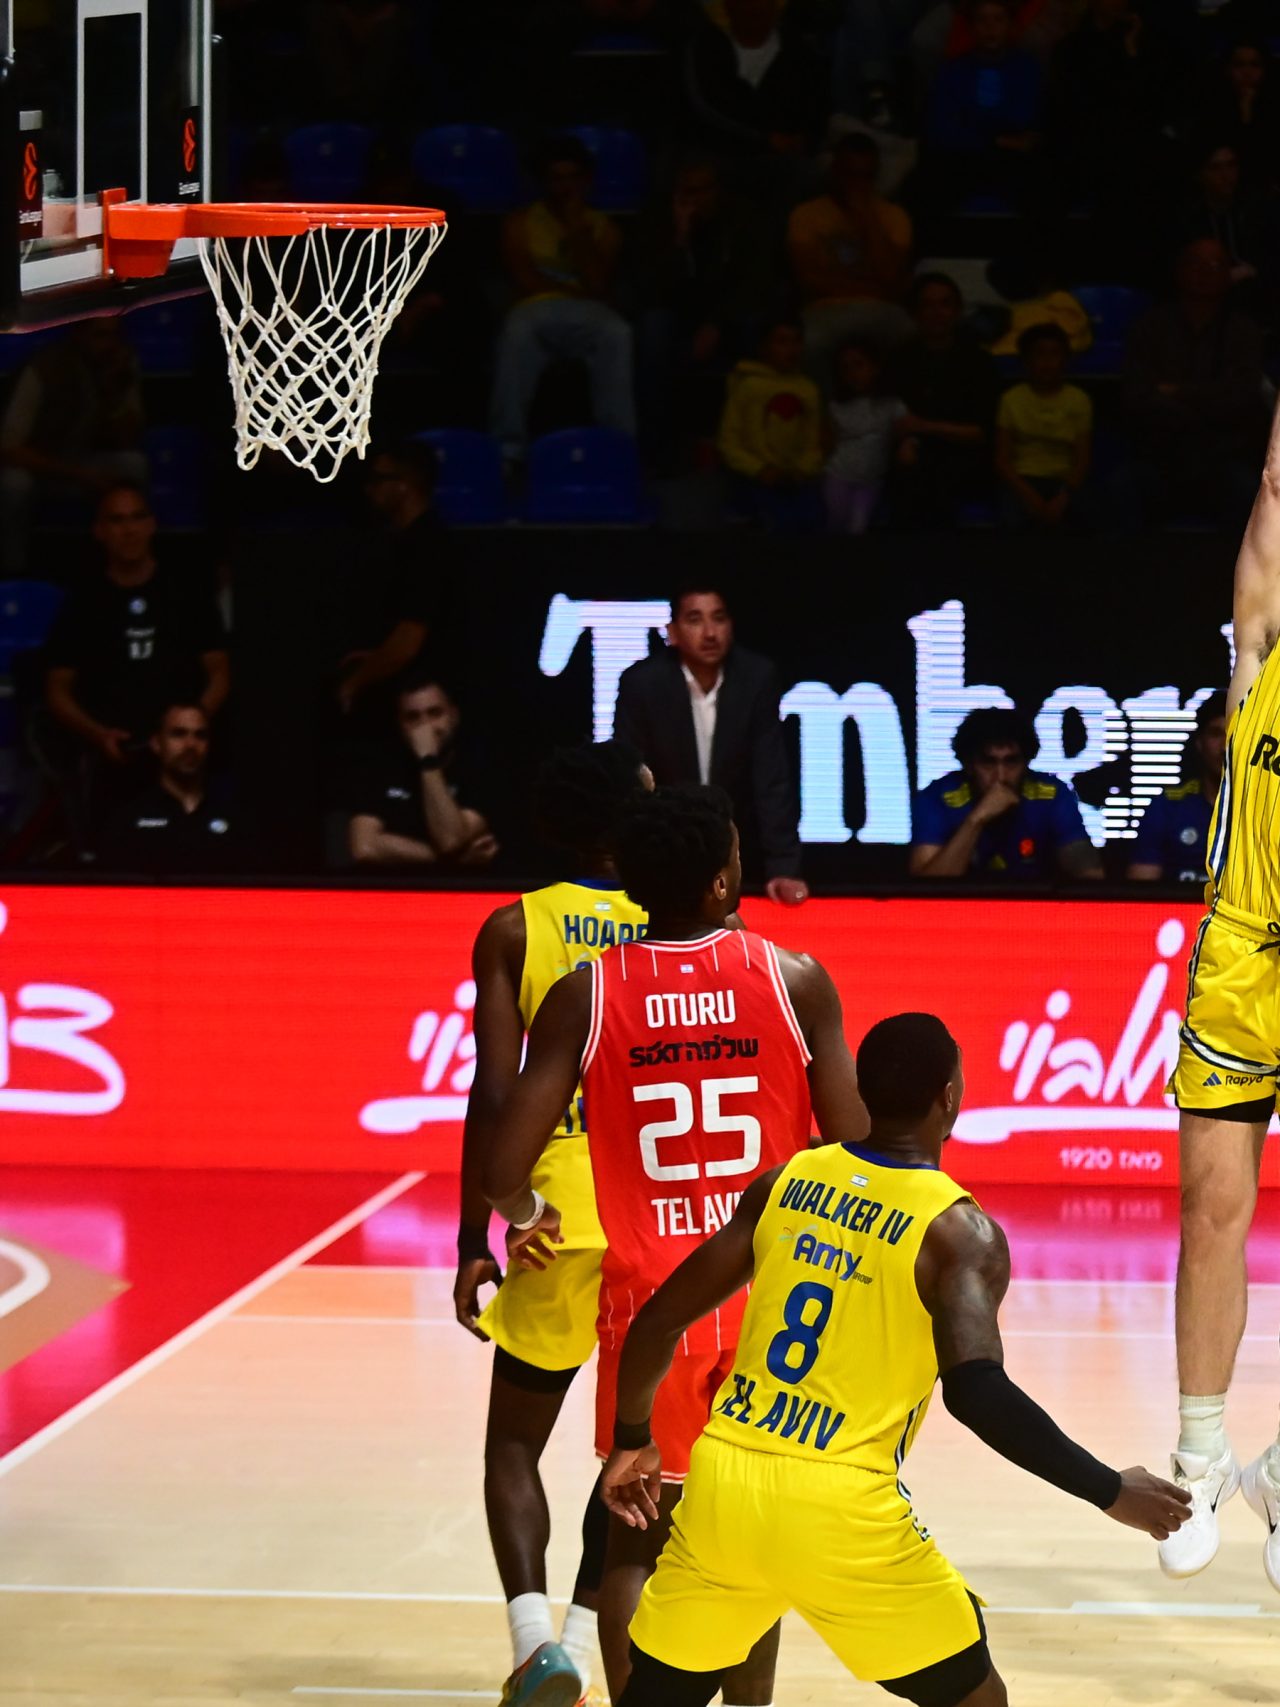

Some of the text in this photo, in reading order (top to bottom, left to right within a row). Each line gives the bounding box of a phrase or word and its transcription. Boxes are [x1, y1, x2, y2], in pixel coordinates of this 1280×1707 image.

[645, 989, 737, 1029] OTURU
[1225, 1075, 1265, 1087] Rapyd
[632, 1075, 762, 1182] 25
[1060, 1147, 1113, 1170] 1920
[650, 1190, 745, 1237] TEL AV
[779, 1177, 914, 1246] WALKER IV
[793, 1233, 863, 1282] Amy
[766, 1281, 834, 1386] 8
[754, 1391, 847, 1451] AVIV
